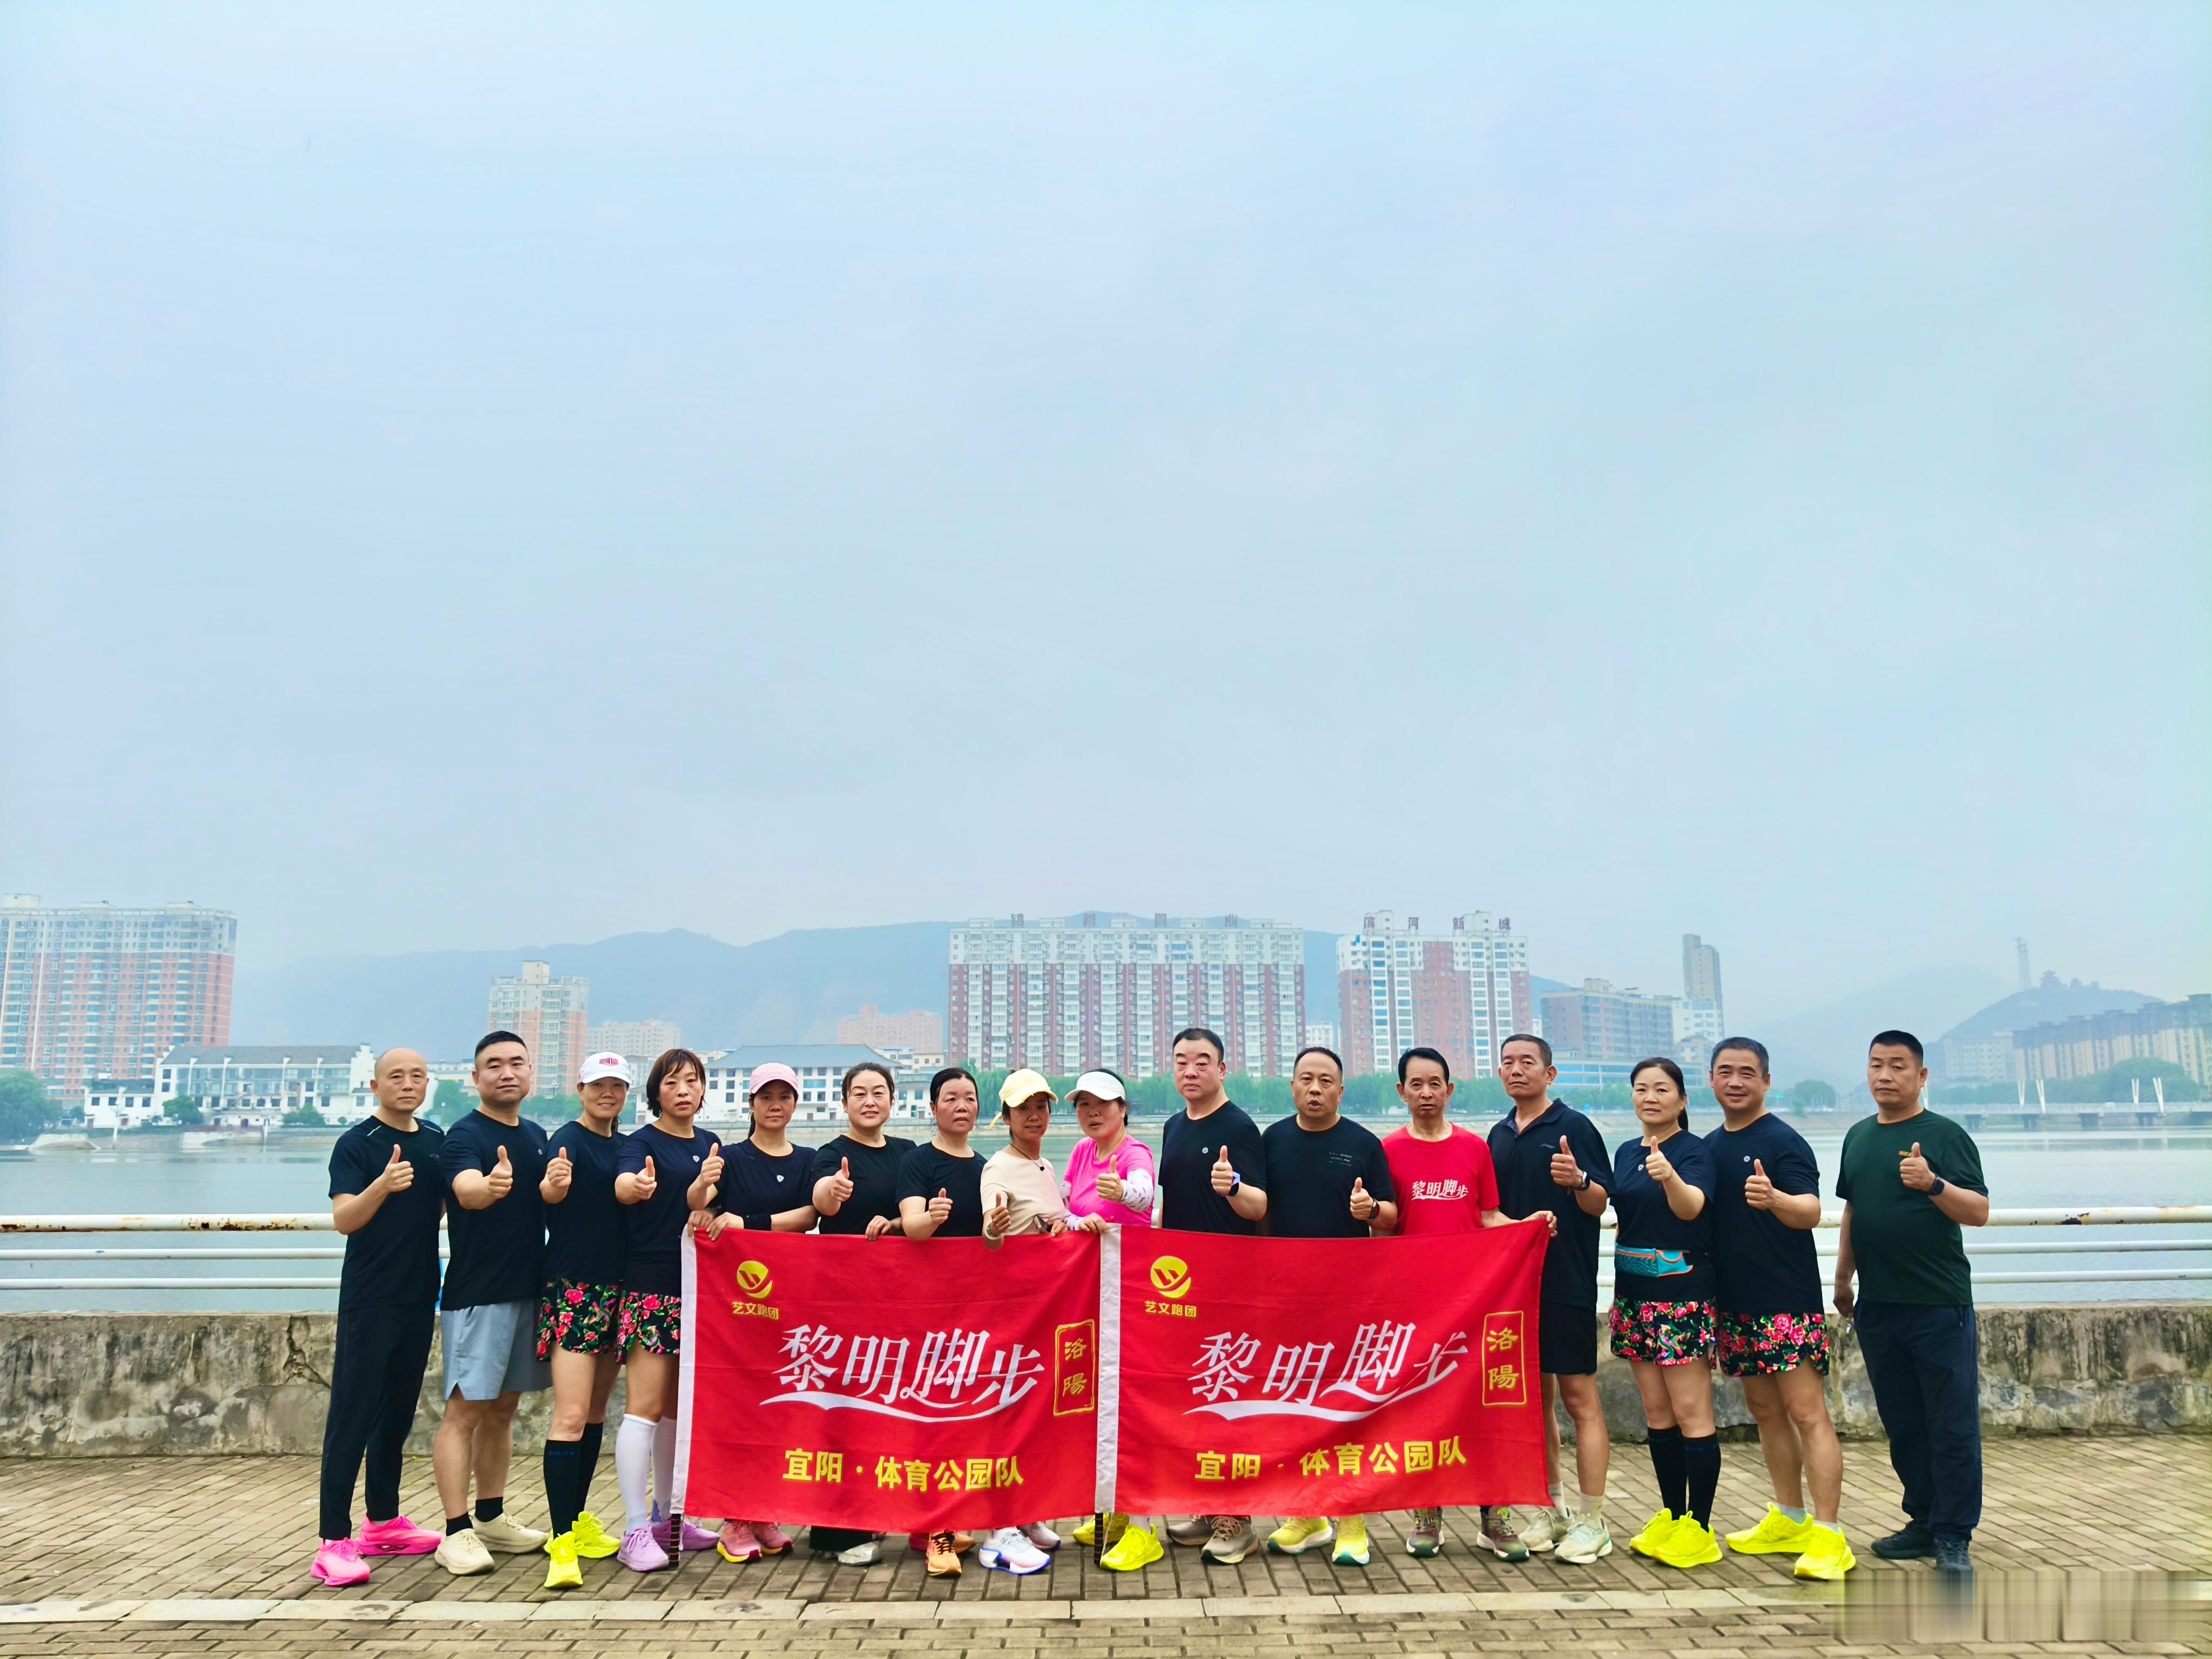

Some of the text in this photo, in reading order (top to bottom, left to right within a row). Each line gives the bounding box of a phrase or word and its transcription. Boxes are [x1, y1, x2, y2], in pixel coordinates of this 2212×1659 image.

[1411, 1179, 1469, 1199] 黎明脚步
[732, 1301, 779, 1320] 艺文跑团
[1144, 1300, 1197, 1318] 艺文跑团
[764, 1324, 1046, 1418] 黎明脚步
[1185, 1319, 1468, 1417] 黎明脚步
